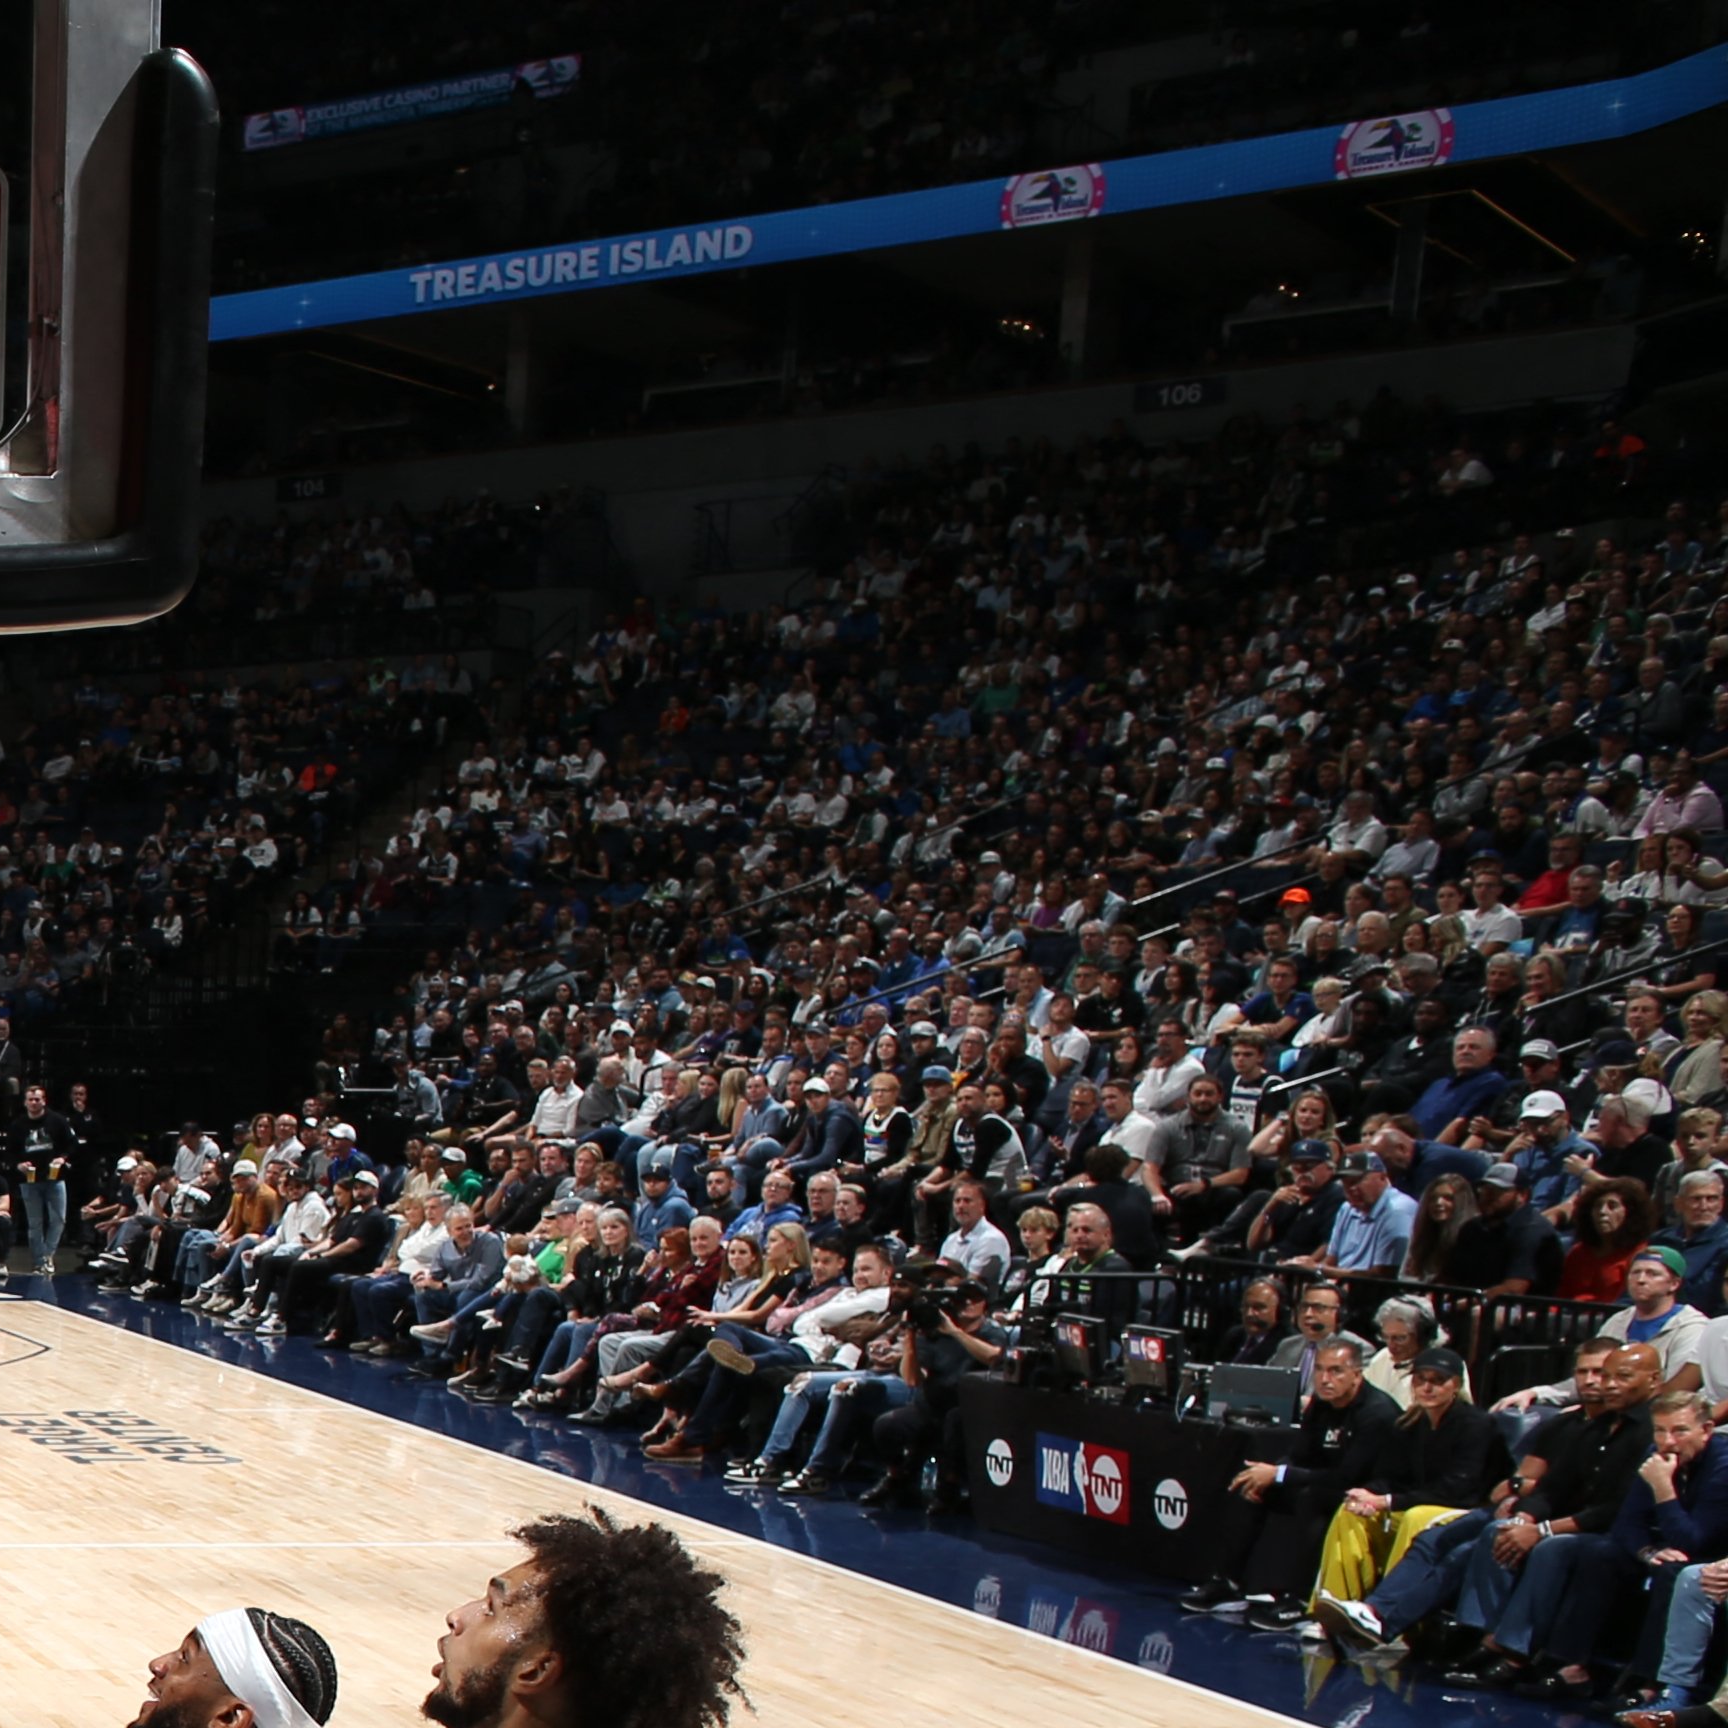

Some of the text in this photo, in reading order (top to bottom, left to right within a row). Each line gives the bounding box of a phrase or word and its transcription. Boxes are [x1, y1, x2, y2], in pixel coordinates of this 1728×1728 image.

[308, 72, 511, 122] EXCLUSIVE CASINO PARTNER
[409, 225, 753, 304] TREASURE ISLAND
[1158, 383, 1203, 406] 106
[986, 1454, 1014, 1475] TNT
[1042, 1447, 1070, 1495] NBA
[1154, 1495, 1188, 1518] TNT
